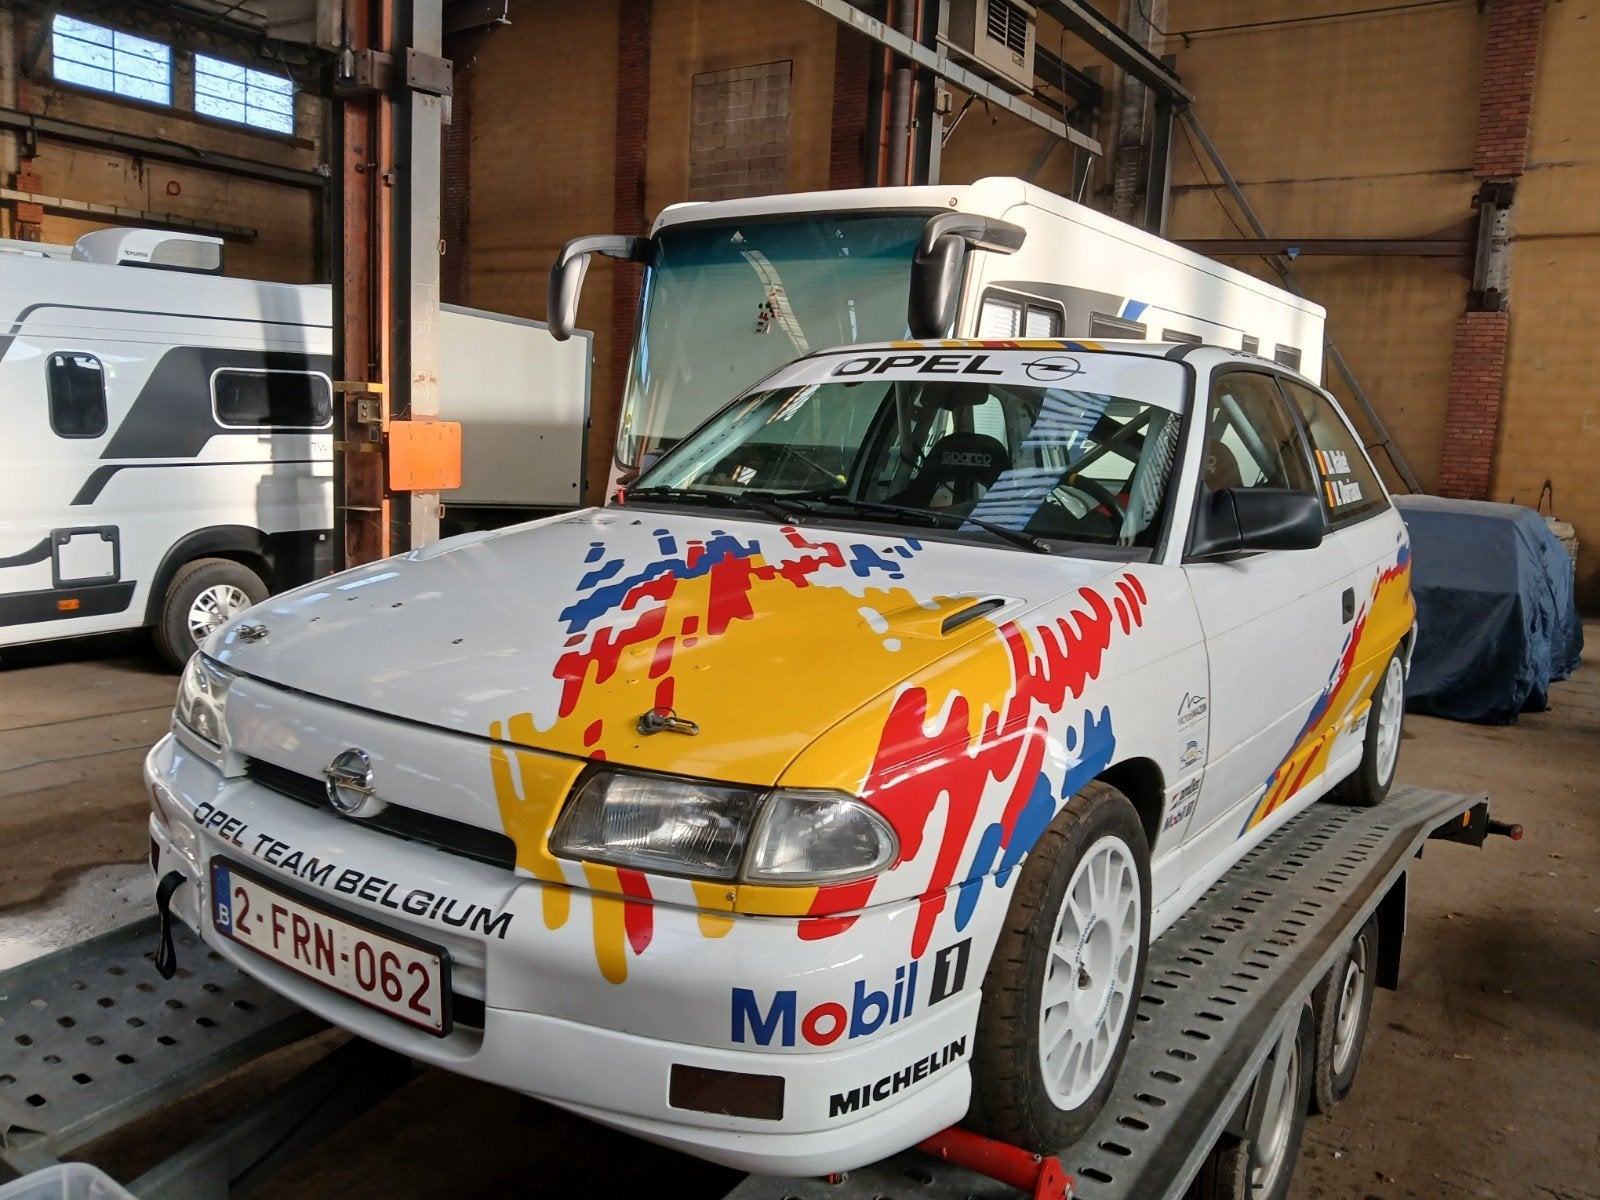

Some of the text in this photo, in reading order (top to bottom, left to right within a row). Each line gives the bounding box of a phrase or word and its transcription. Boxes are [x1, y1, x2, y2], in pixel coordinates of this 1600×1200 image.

[831, 354, 1003, 377] OPEL
[193, 801, 515, 939] OPEL TEAM BELGIUM
[217, 903, 230, 926] B
[731, 960, 919, 1047] Mobil
[828, 1034, 967, 1118] MICHELIN
